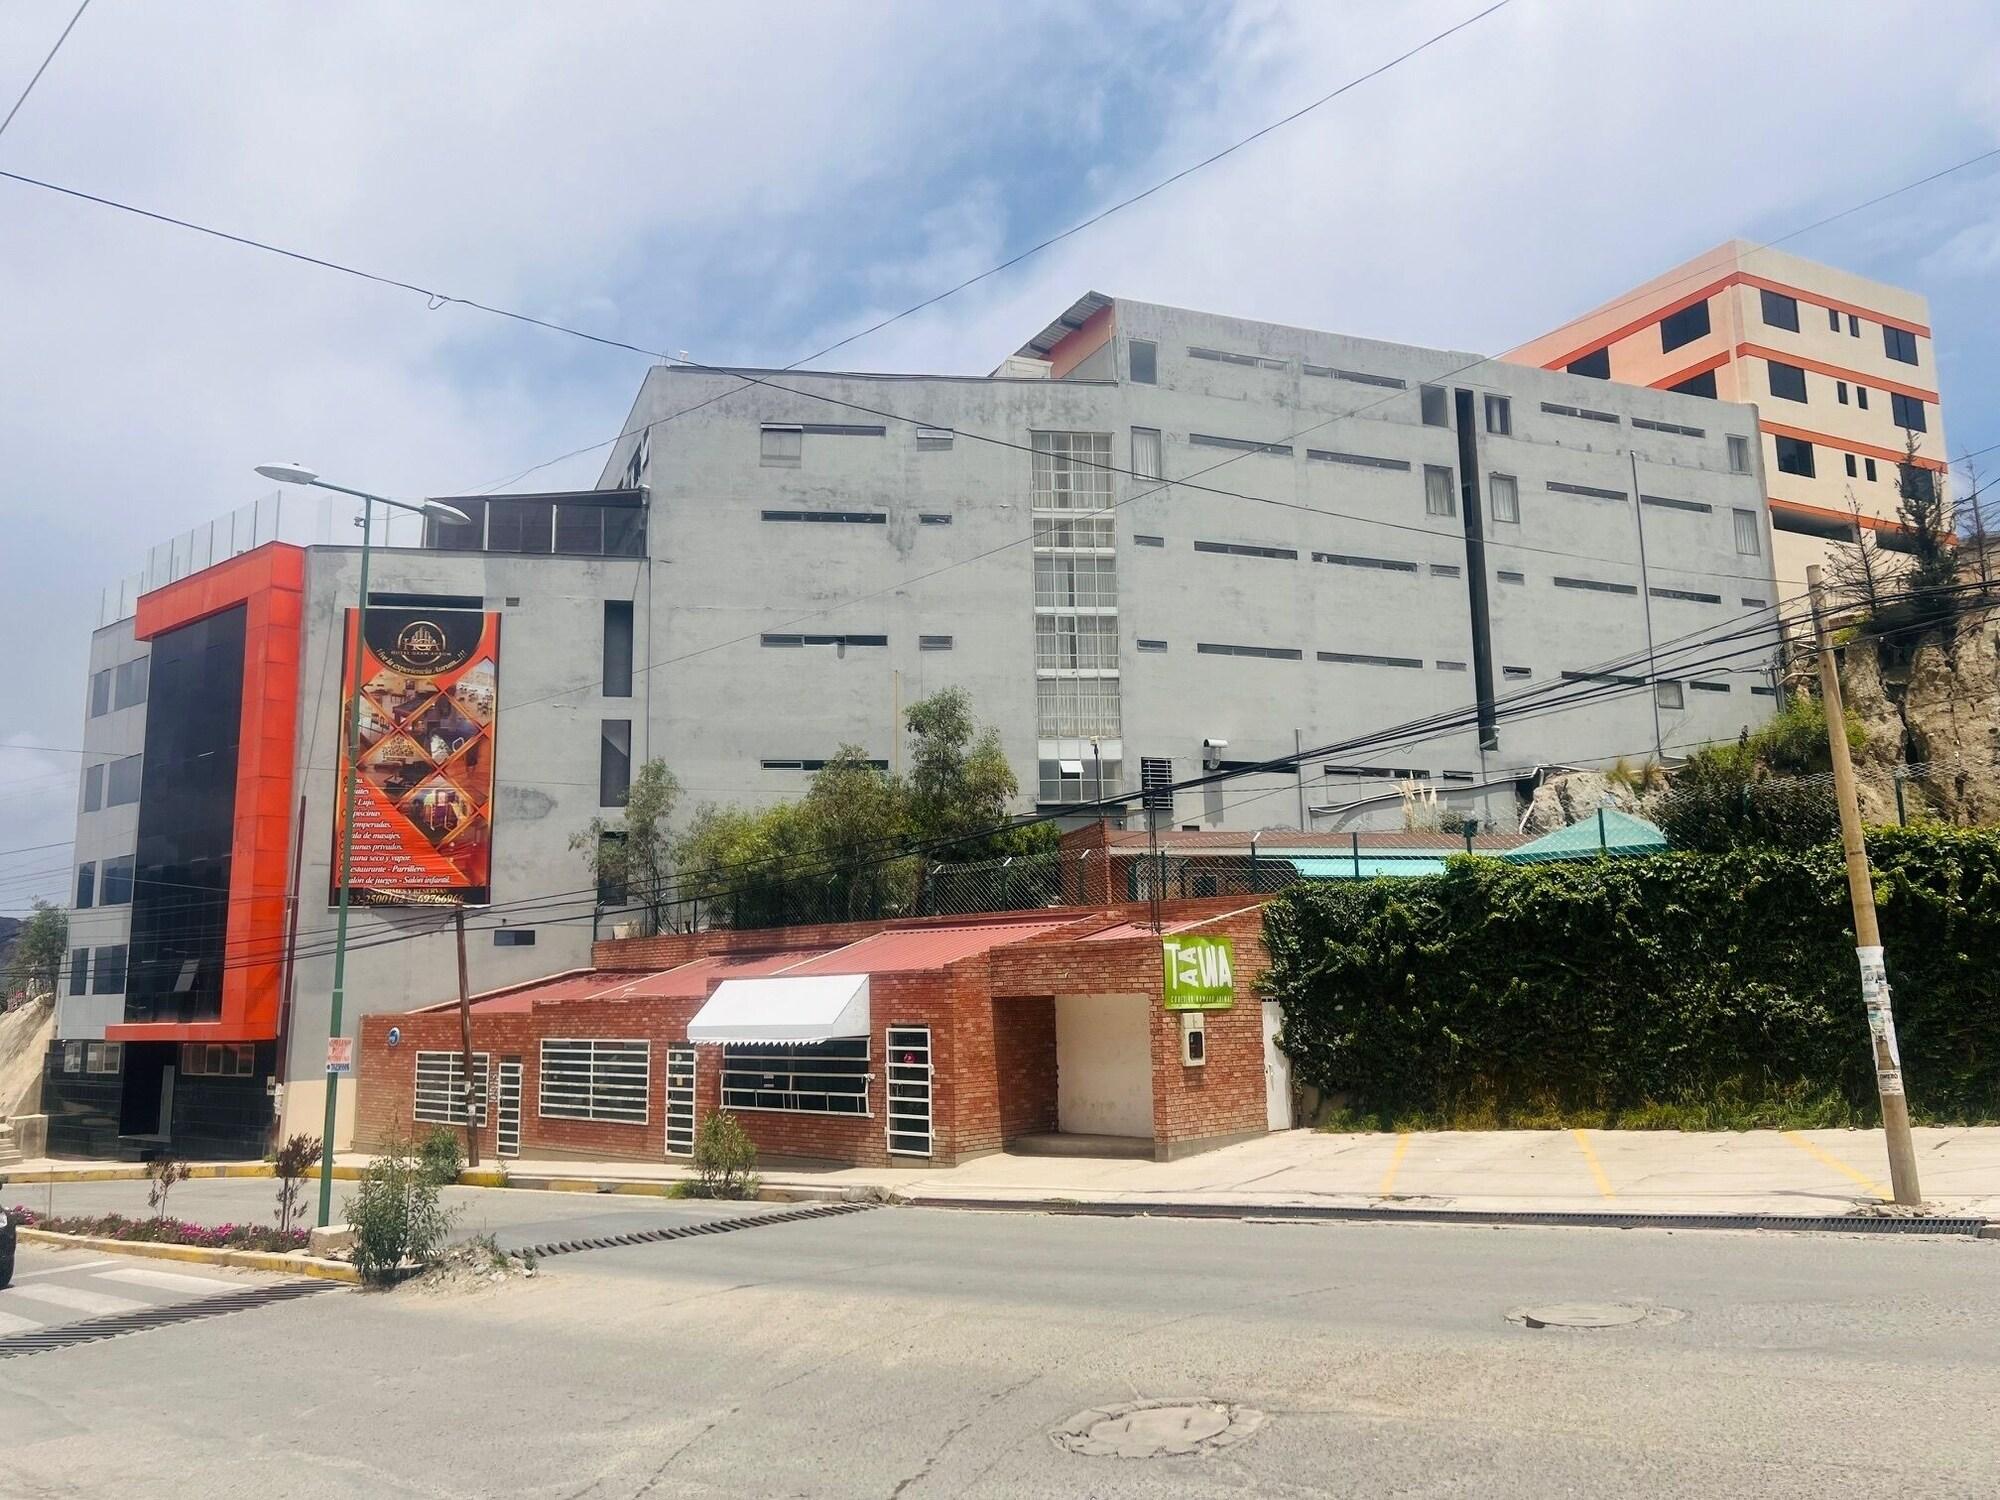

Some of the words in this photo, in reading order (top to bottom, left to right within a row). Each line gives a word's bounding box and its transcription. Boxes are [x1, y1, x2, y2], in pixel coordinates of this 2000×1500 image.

[352, 811, 381, 819] piscinas
[362, 831, 372, 839] de
[365, 876, 374, 884] de
